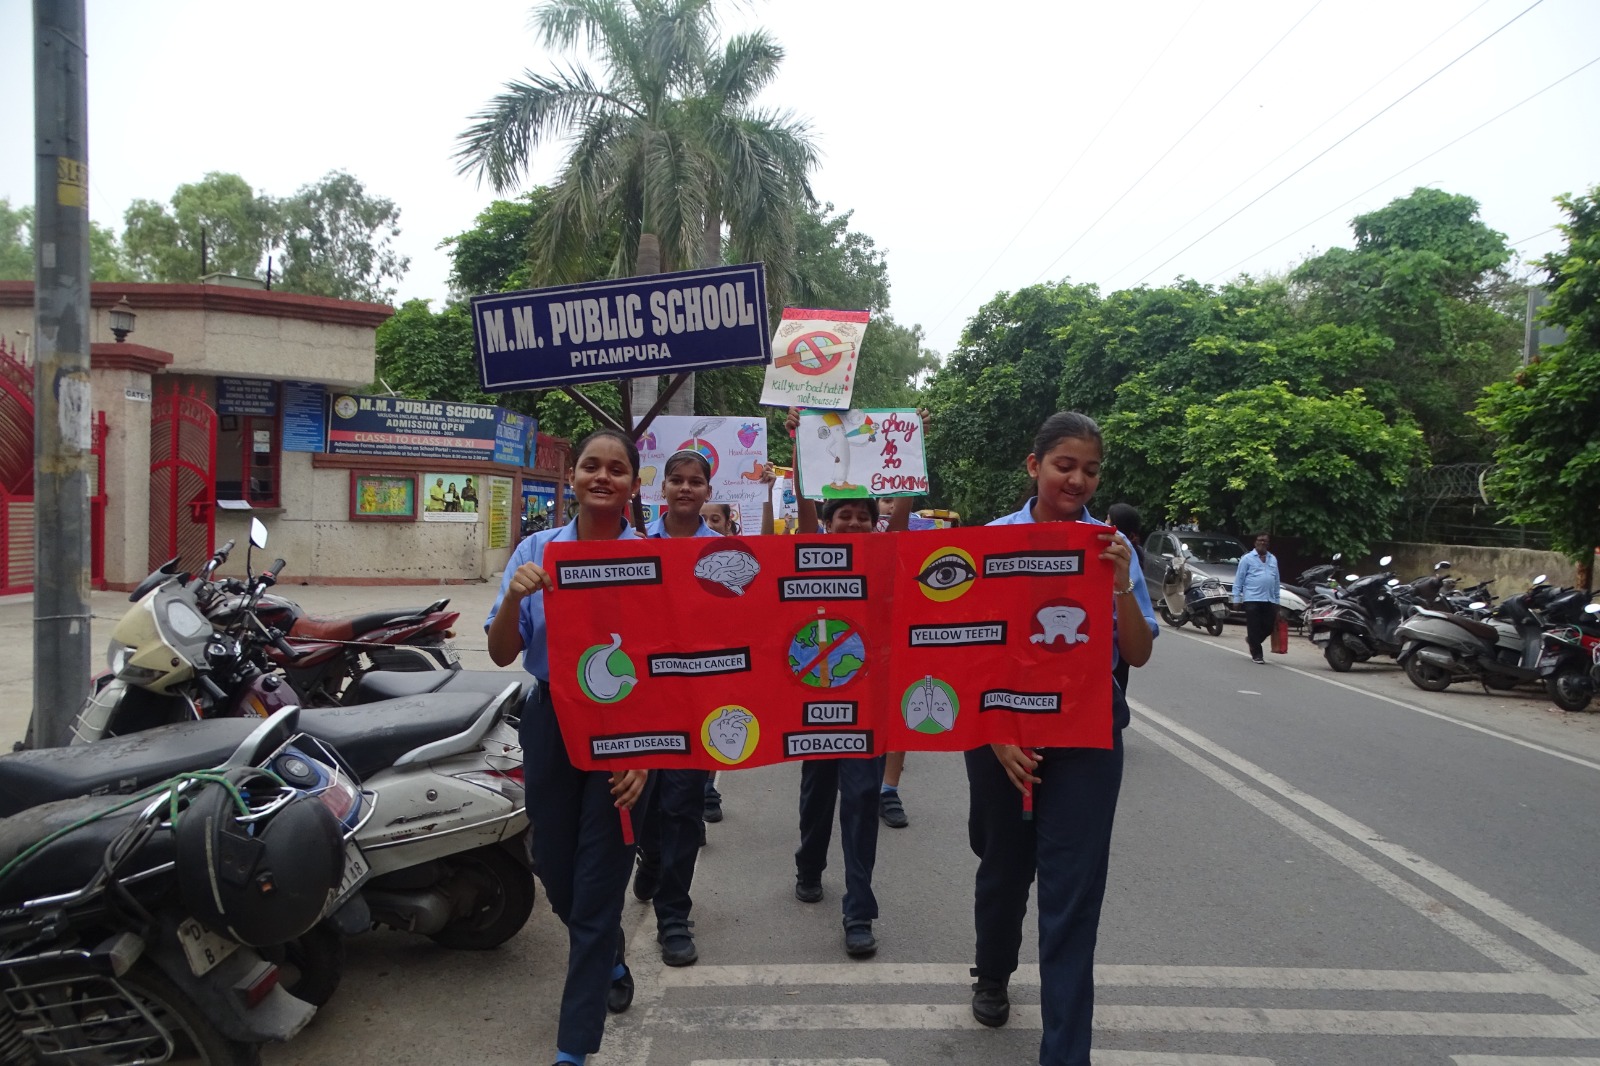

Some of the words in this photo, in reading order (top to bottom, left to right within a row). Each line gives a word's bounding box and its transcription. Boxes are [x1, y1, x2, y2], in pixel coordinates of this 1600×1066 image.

[483, 306, 544, 353] M.M.
[548, 294, 644, 346] PUBLIC
[650, 282, 754, 336] SCHOOL
[570, 343, 672, 367] PITAMPURA
[772, 380, 787, 390] Kill
[805, 380, 822, 393] bad
[823, 382, 845, 394] habit
[797, 393, 810, 404] not
[360, 398, 391, 412] M.M.
[395, 401, 443, 416] PUBLIC
[446, 405, 495, 420] SCHOOL
[386, 419, 438, 430] ADMISSION
[441, 422, 465, 432] OPEN
[355, 433, 392, 442] CLASS-I
[395, 435, 408, 443] TO
[411, 436, 453, 448] CLASS-IX
[455, 440, 463, 448] &
[464, 440, 474, 448] XI
[871, 473, 928, 491] SMOKING
[802, 551, 844, 565] STOP
[988, 561, 1015, 572] EYES
[1018, 559, 1073, 570] DISEASES
[564, 568, 601, 580] BRAIN
[604, 566, 650, 578] STROKE
[787, 581, 860, 595] SMOKING
[914, 629, 962, 641] YELLOW
[965, 628, 999, 639] TEETH
[654, 659, 701, 671] STOMACH
[704, 657, 743, 669] CANCER
[985, 692, 1011, 704] LUNG
[1013, 696, 1055, 707] CANCER
[810, 707, 850, 721] QUIT
[596, 740, 631, 751] HEART
[633, 738, 681, 749] DISEASES
[790, 737, 865, 751] TOBACCO
